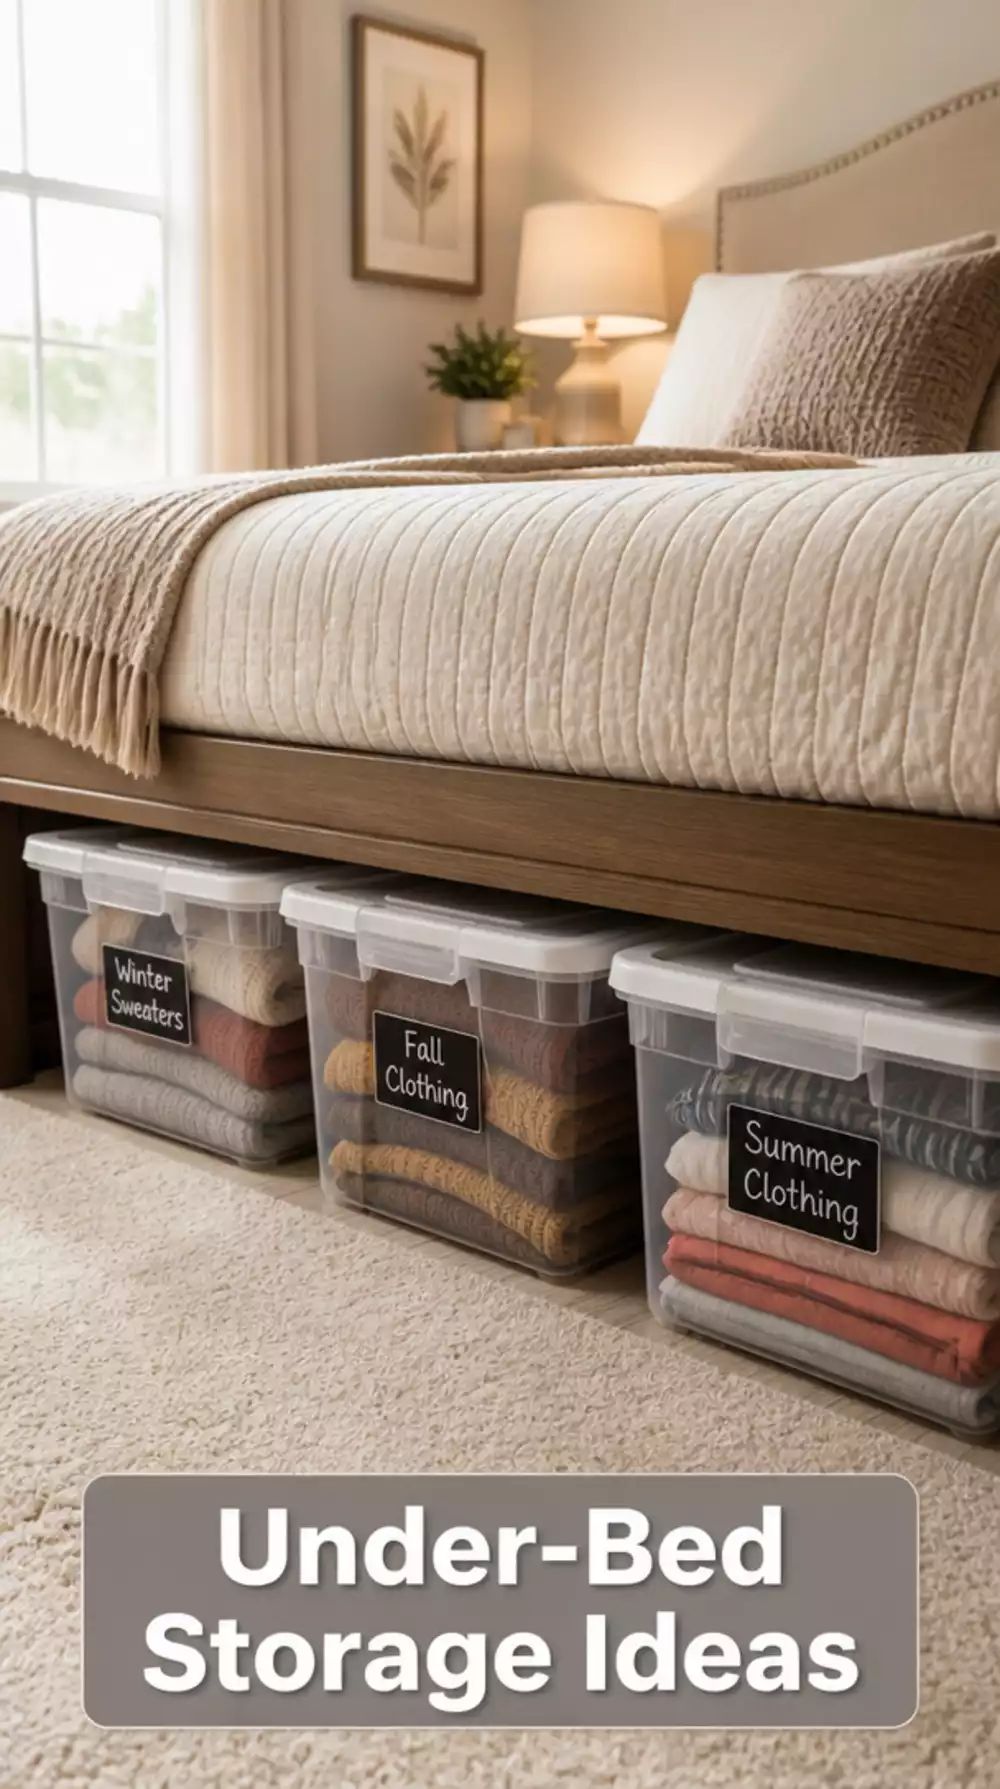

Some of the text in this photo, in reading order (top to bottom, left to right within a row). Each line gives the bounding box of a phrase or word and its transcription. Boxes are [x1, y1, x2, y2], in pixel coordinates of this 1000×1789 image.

[114, 957, 173, 992] Winter
[111, 988, 184, 1031] Sweaters
[404, 1029, 445, 1067] Fall
[385, 1065, 469, 1122] Clothing
[745, 1120, 861, 1180] Summer
[744, 1168, 859, 1241] Clothing
